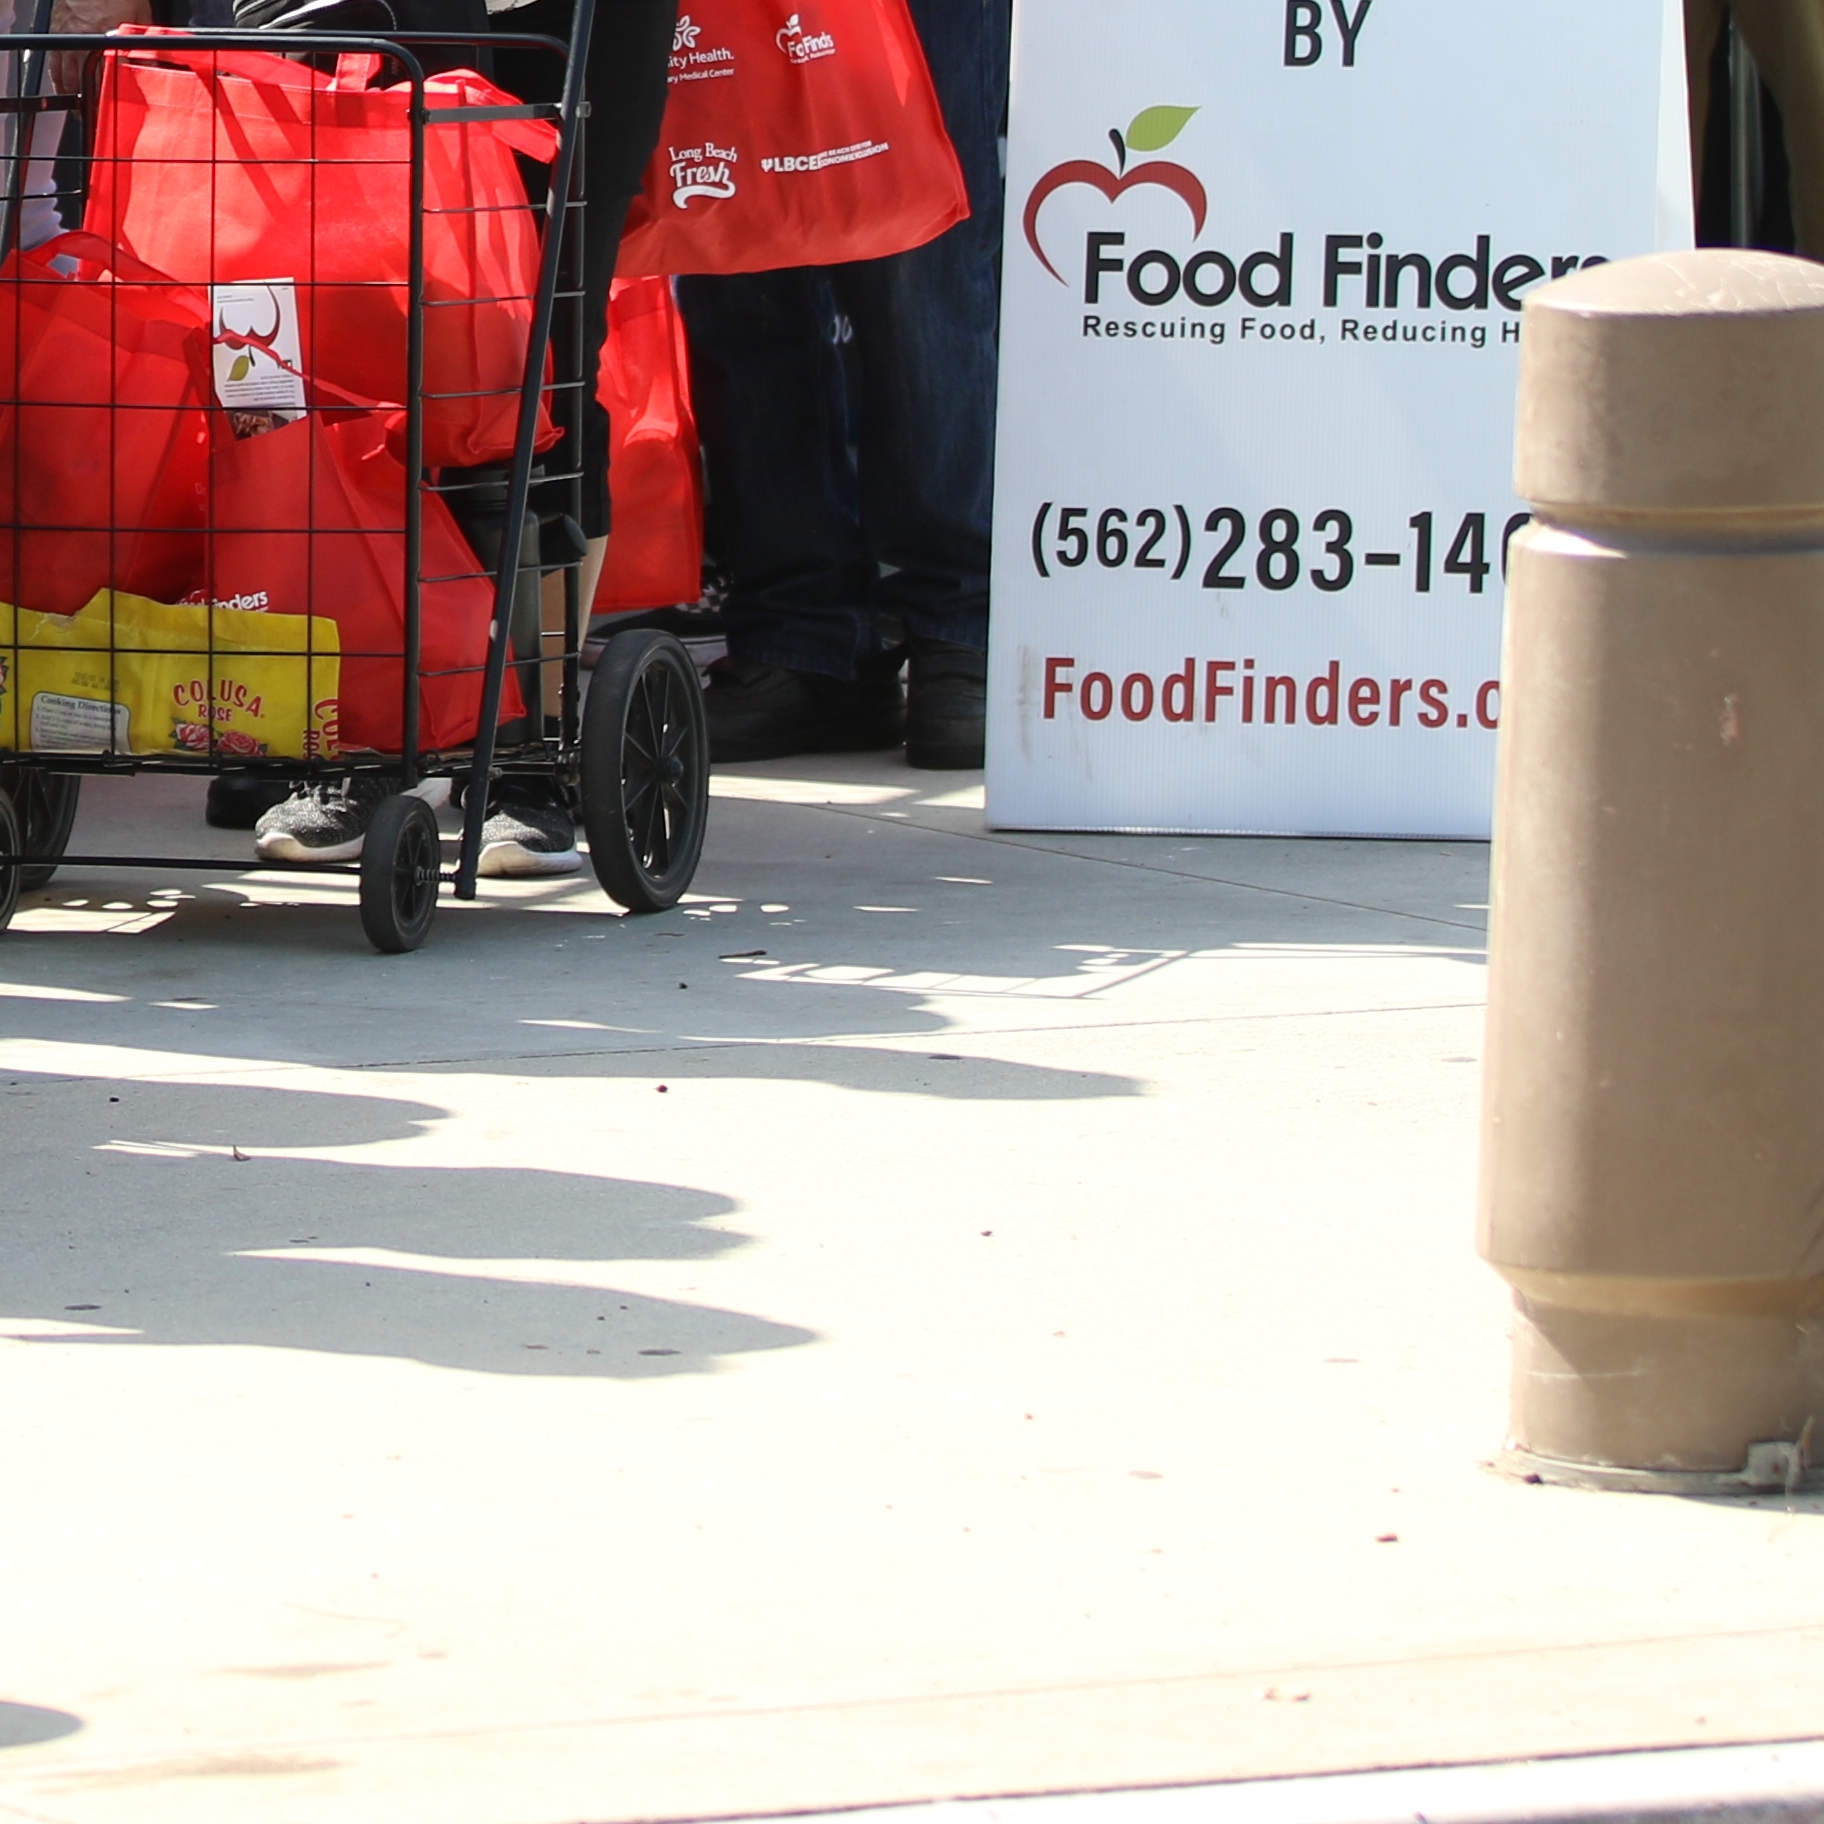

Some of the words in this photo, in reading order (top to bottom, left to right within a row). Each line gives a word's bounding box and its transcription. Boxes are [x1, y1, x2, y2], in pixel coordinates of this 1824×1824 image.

[668, 146, 702, 162] Long
[704, 141, 738, 163] Beach
[669, 161, 731, 188] Fresh
[1083, 231, 1294, 308] Food
[1322, 232, 1610, 311] Finder
[1082, 315, 1226, 345] Rescuing
[1240, 317, 1326, 344] Food,
[1340, 318, 1486, 349] Reducing
